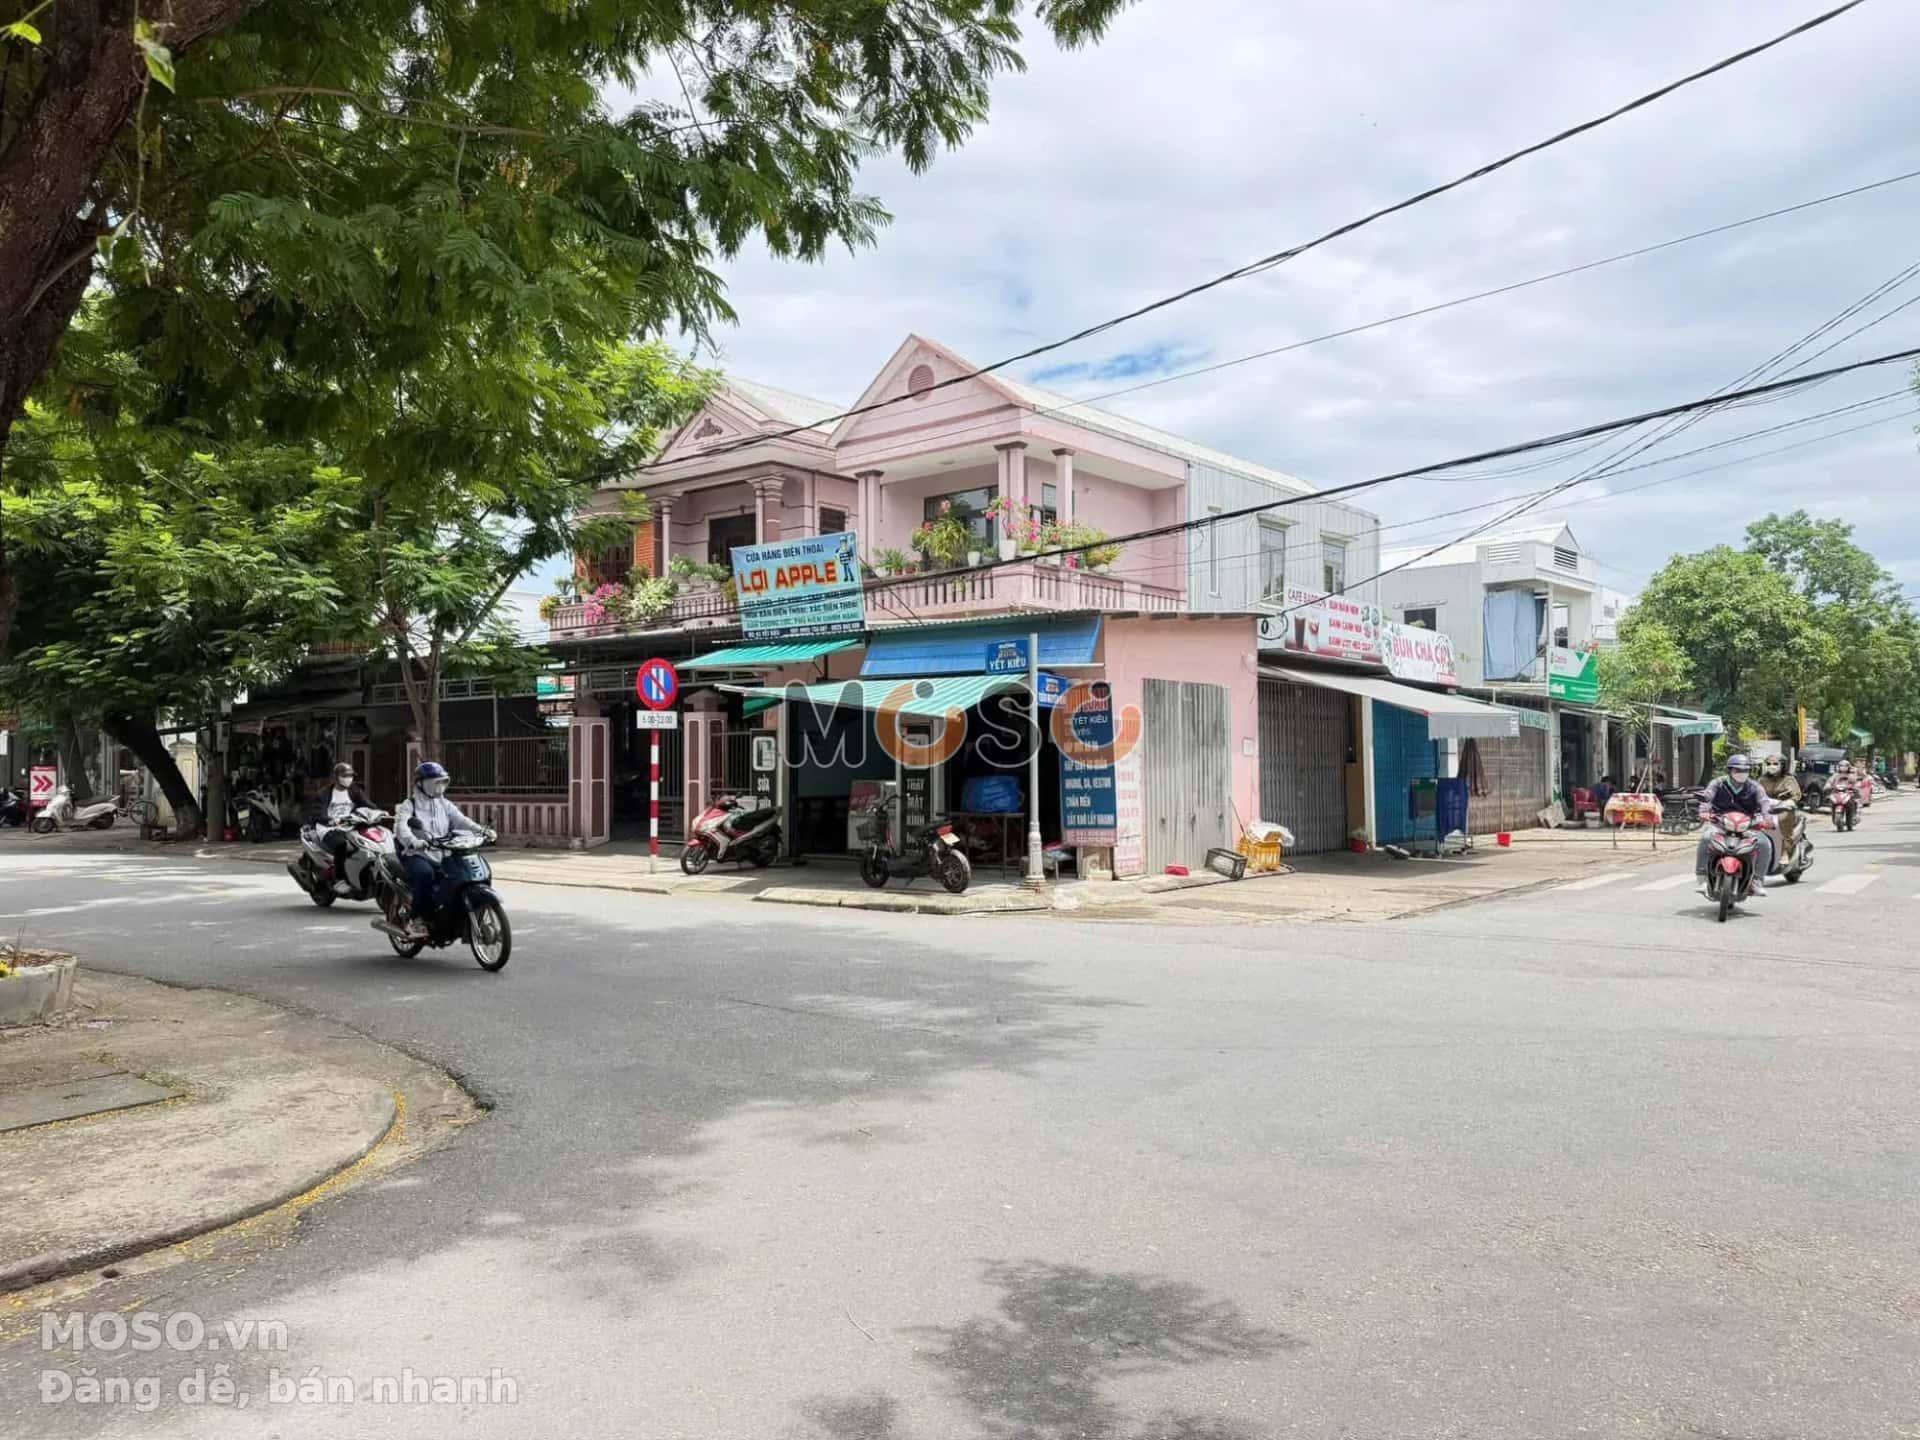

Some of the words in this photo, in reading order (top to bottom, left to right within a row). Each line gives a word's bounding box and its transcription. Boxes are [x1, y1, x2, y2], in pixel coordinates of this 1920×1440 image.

[740, 567, 768, 596] LỢI
[776, 561, 837, 590] APPLE
[990, 656, 1005, 671] YẾT
